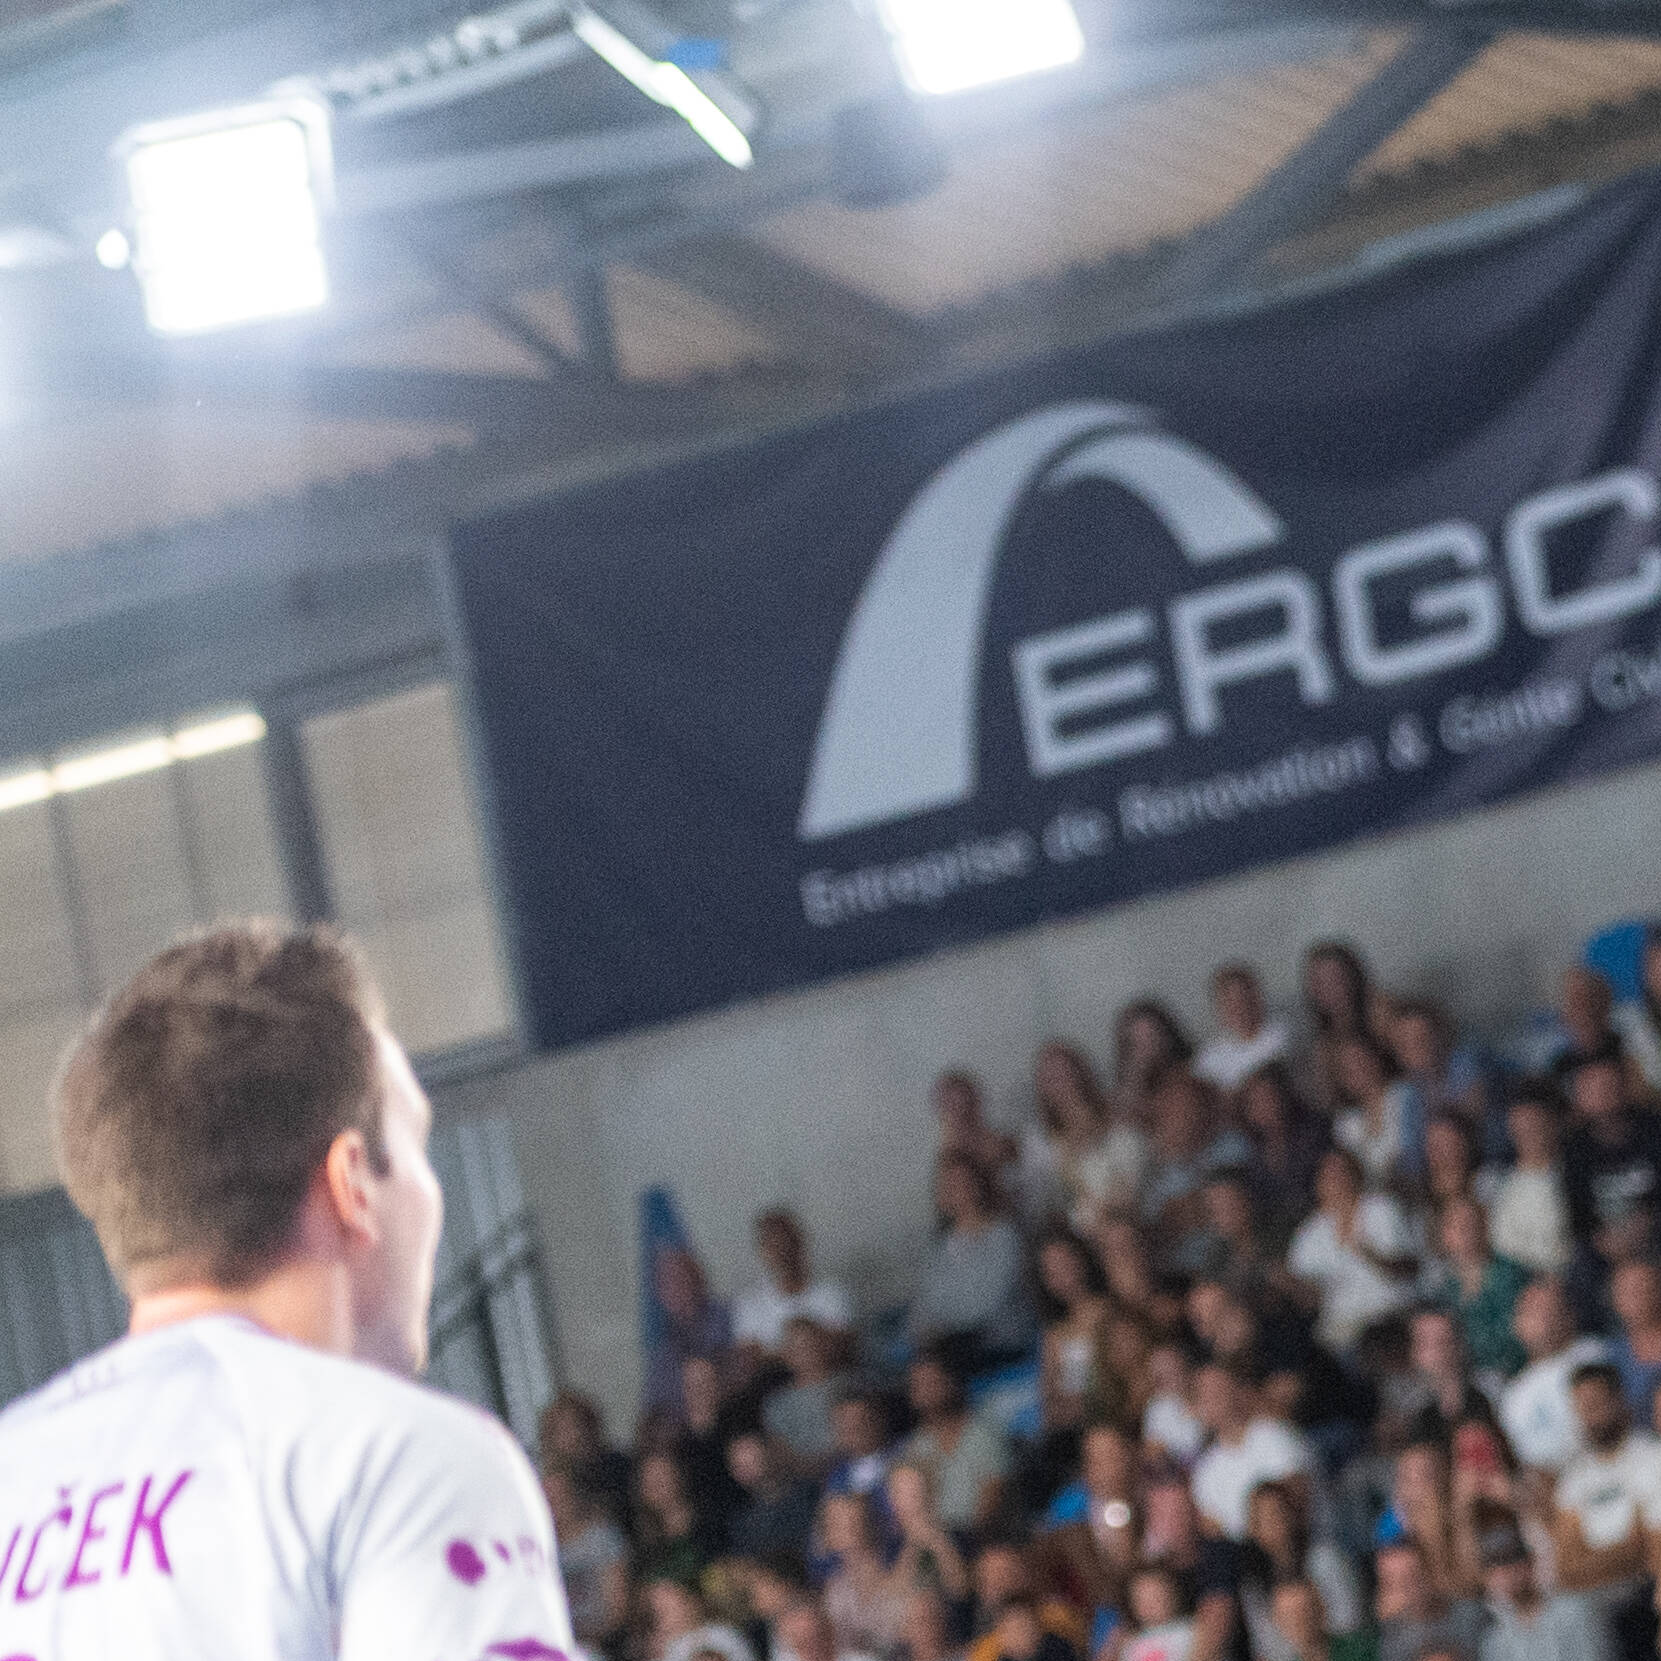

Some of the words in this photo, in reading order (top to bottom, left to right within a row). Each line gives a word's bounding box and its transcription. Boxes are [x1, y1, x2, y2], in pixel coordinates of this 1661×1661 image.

[804, 826, 1032, 926] Entreprise
[1042, 806, 1110, 861] de
[1387, 723, 1426, 771] &
